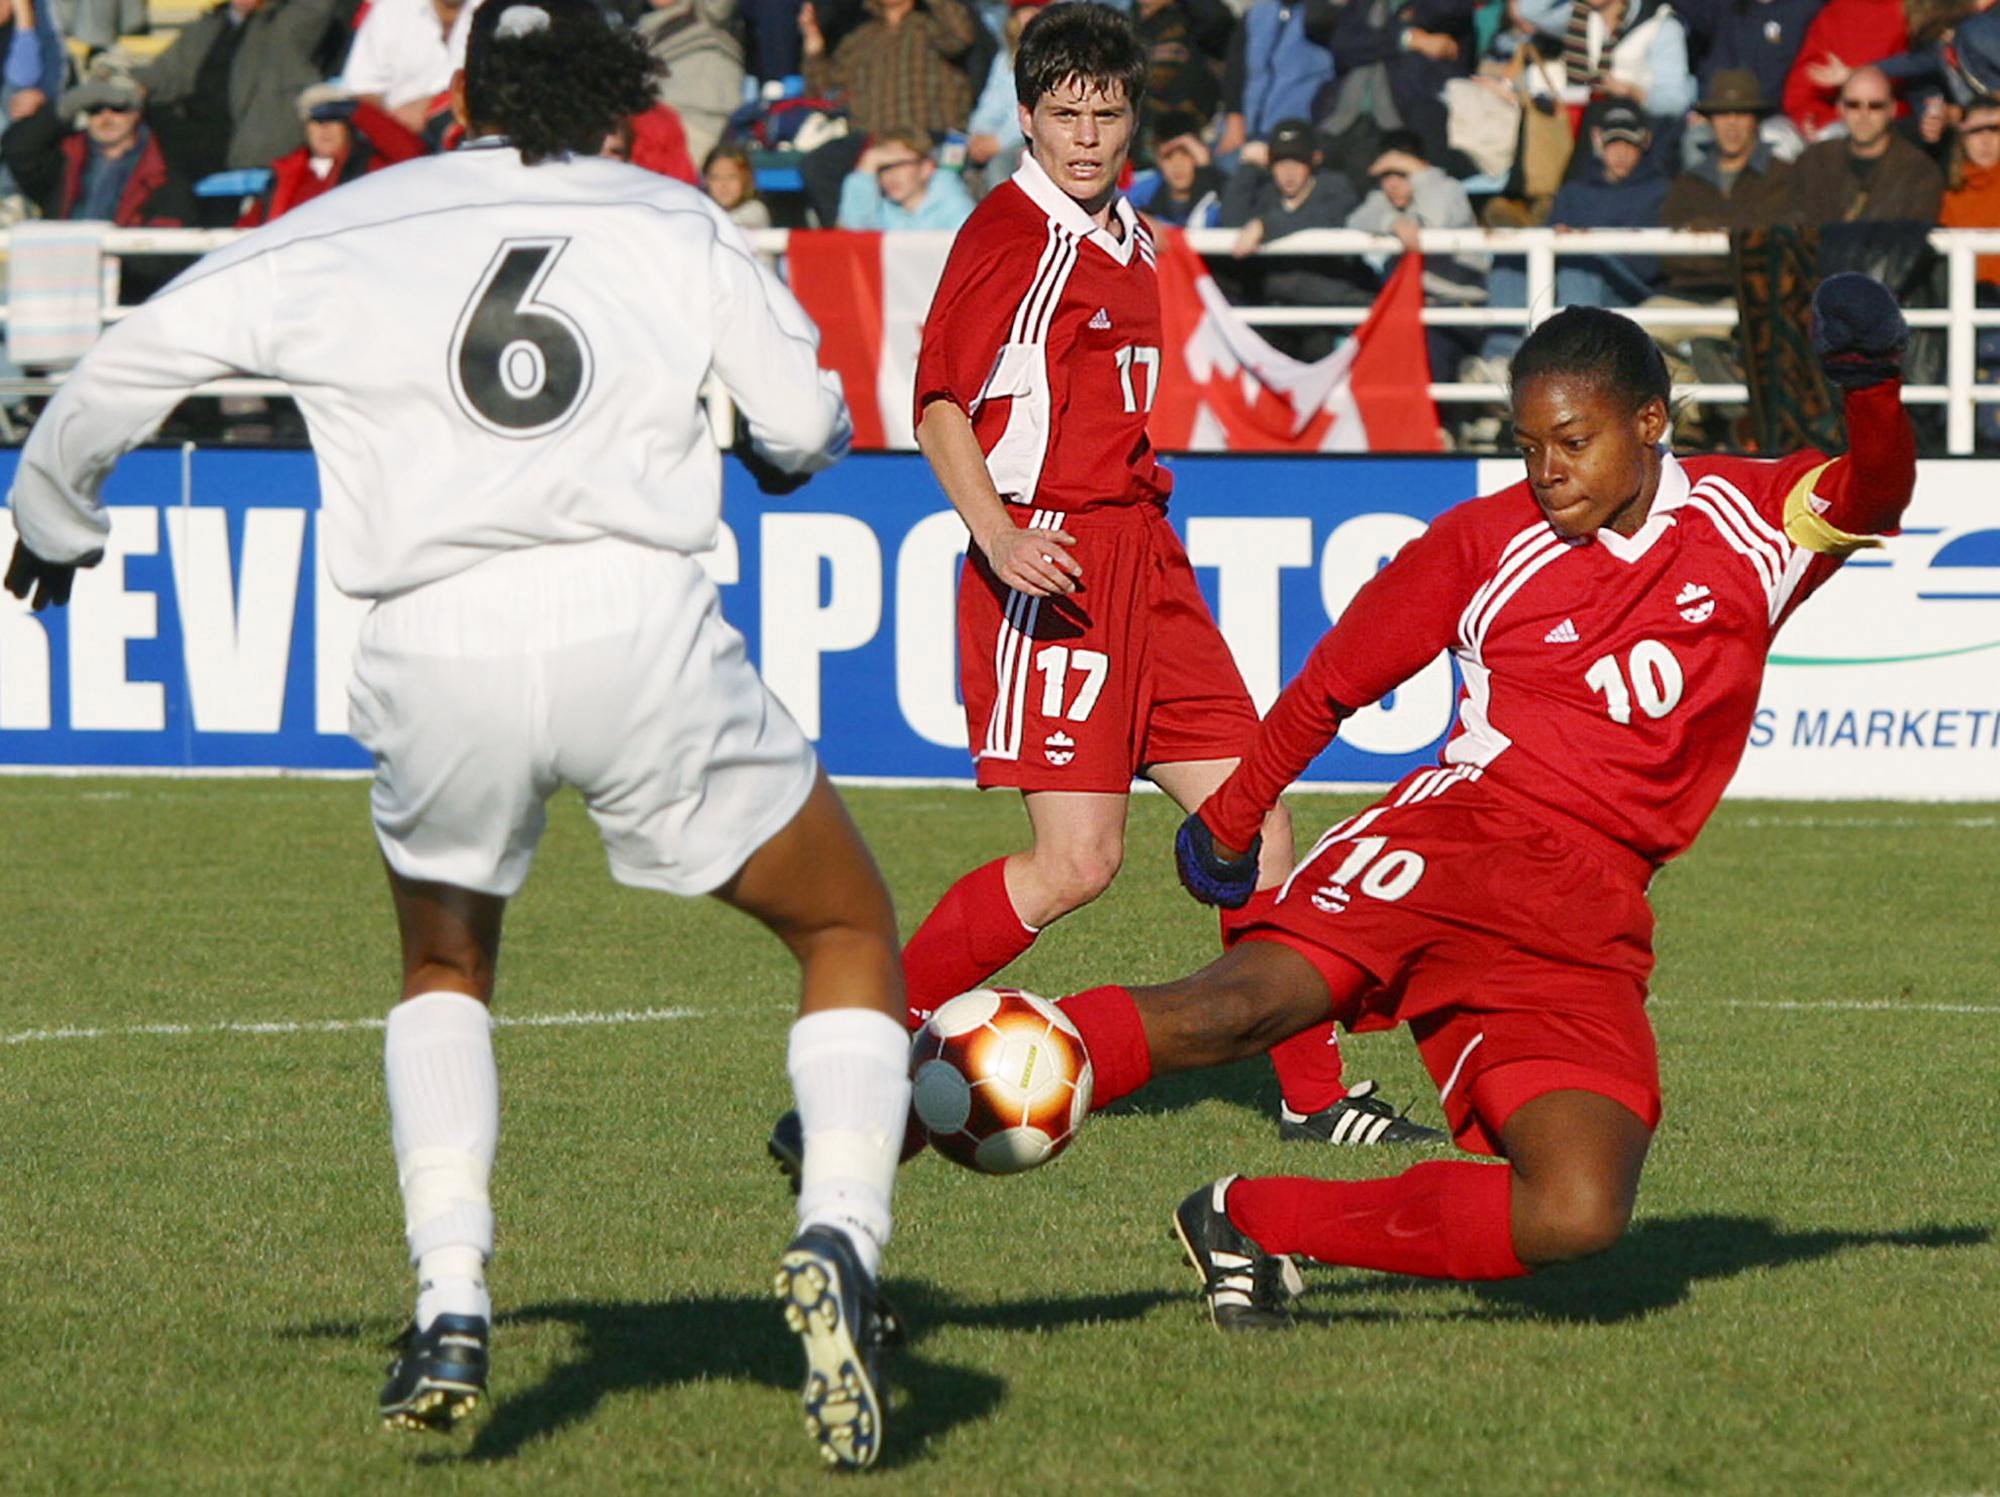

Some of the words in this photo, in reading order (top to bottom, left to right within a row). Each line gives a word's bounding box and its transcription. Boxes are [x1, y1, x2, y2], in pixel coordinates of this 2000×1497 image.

[447, 236, 595, 440] 6
[1114, 345, 1160, 413] 17
[1036, 645, 1109, 722] 17
[1584, 639, 1684, 725] 10
[1328, 836, 1426, 902] 10
